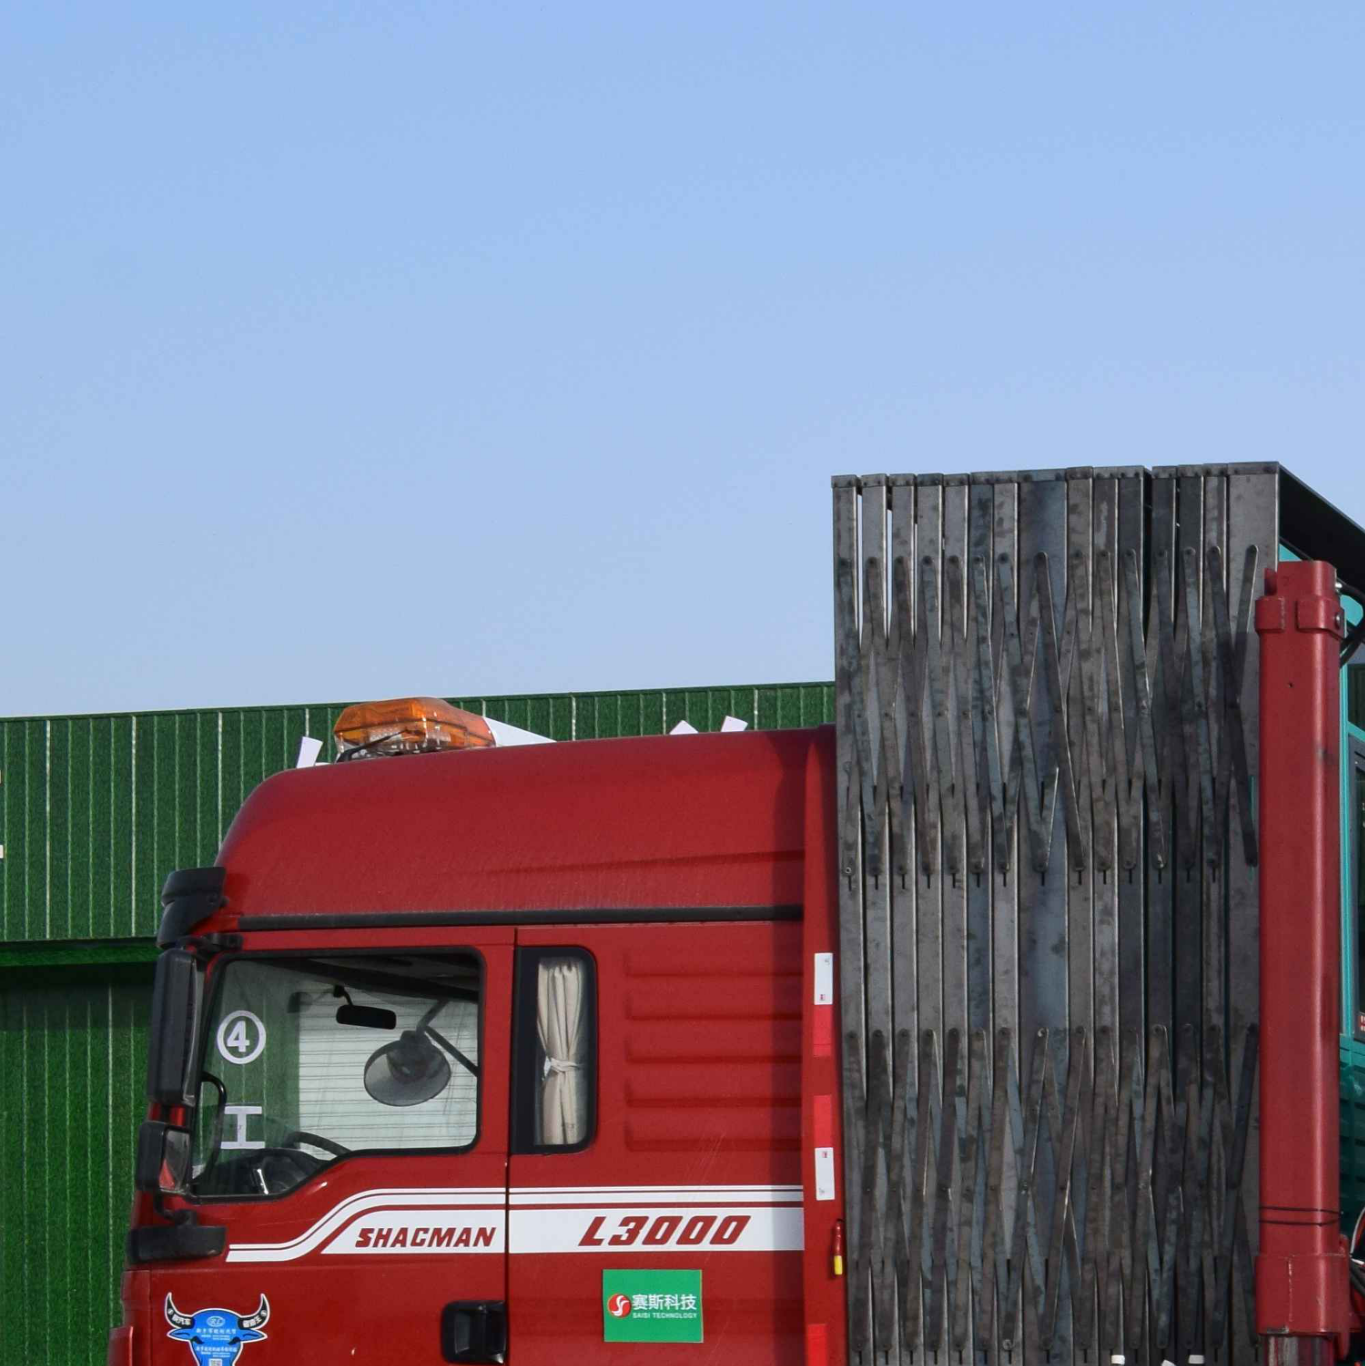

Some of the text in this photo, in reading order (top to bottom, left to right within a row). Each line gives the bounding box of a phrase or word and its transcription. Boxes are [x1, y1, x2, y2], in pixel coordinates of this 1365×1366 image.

[355, 1227, 497, 1248] SHACMAN
[578, 1215, 752, 1246] L3000
[631, 1293, 697, 1310] 赛斯科技
